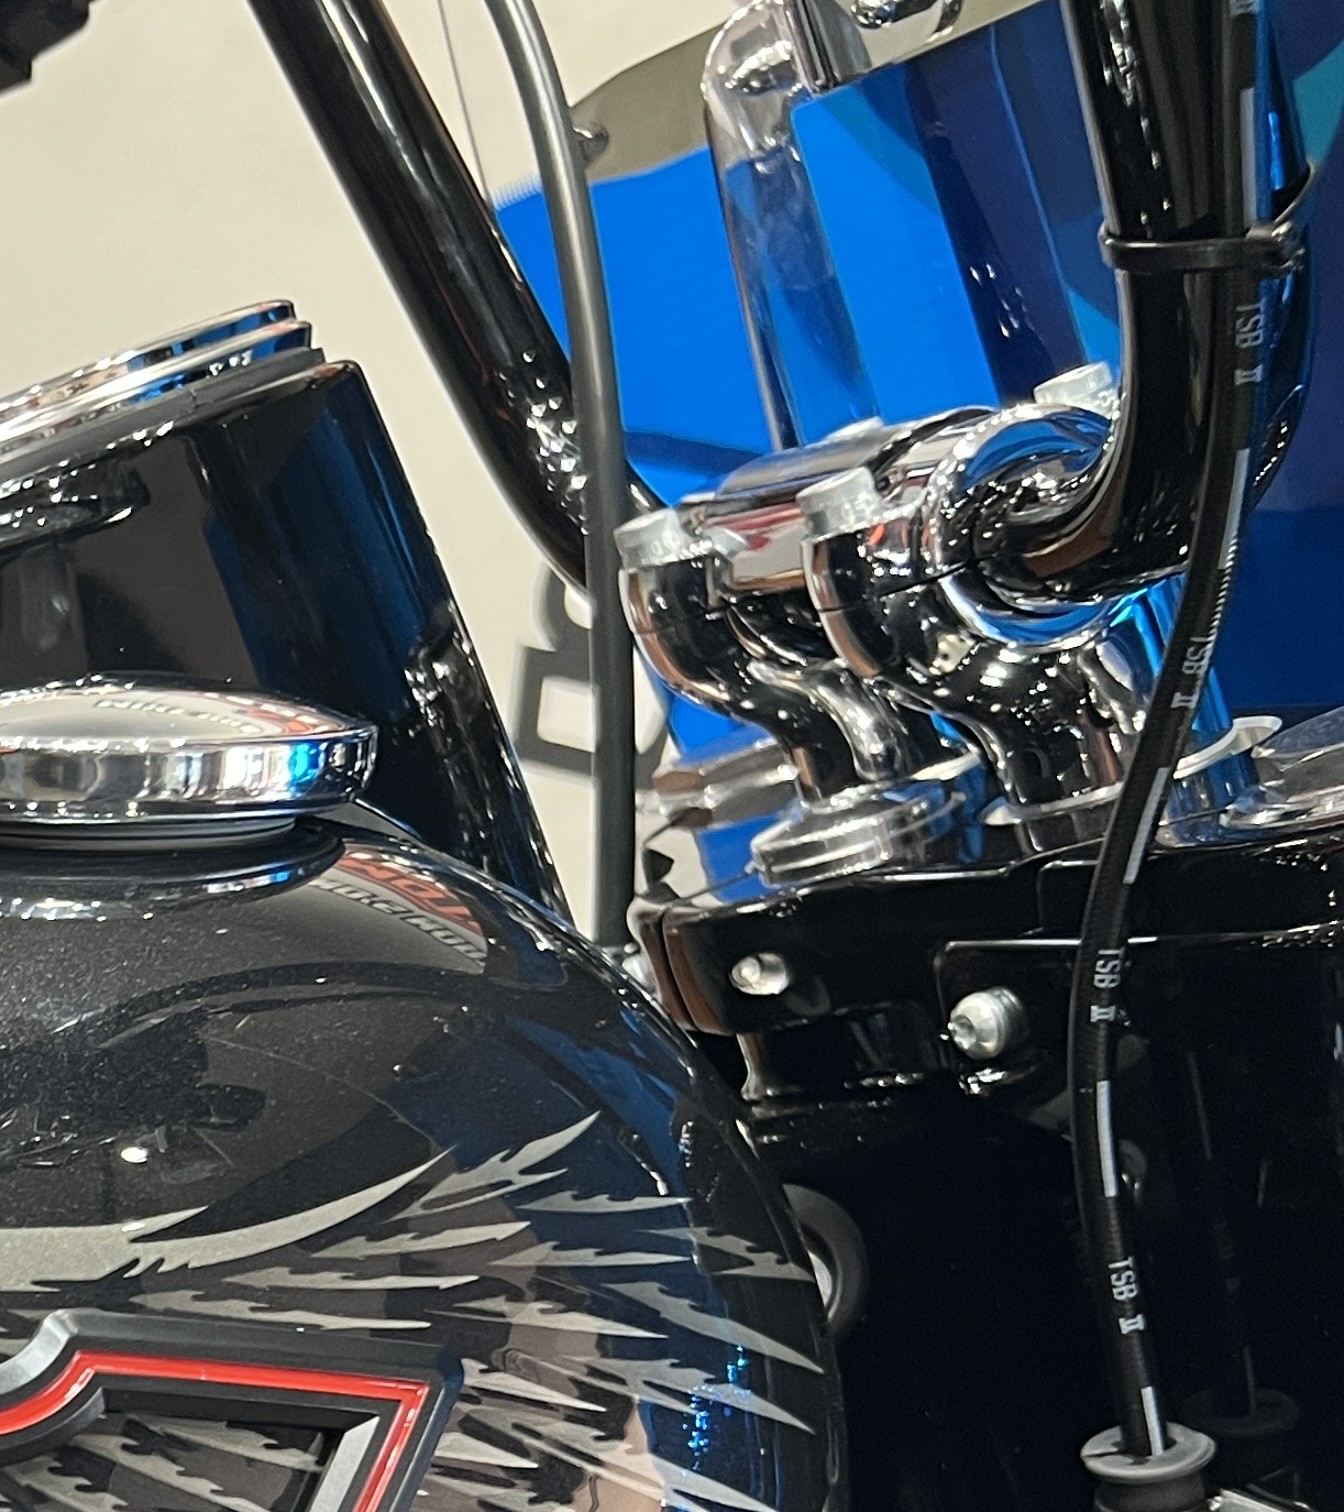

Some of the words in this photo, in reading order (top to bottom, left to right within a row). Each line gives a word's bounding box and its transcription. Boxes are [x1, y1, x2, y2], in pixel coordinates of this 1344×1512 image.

[1235, 298, 1265, 349] TSB
[1092, 946, 1125, 989] TSB
[1108, 1256, 1140, 1302] TSB
